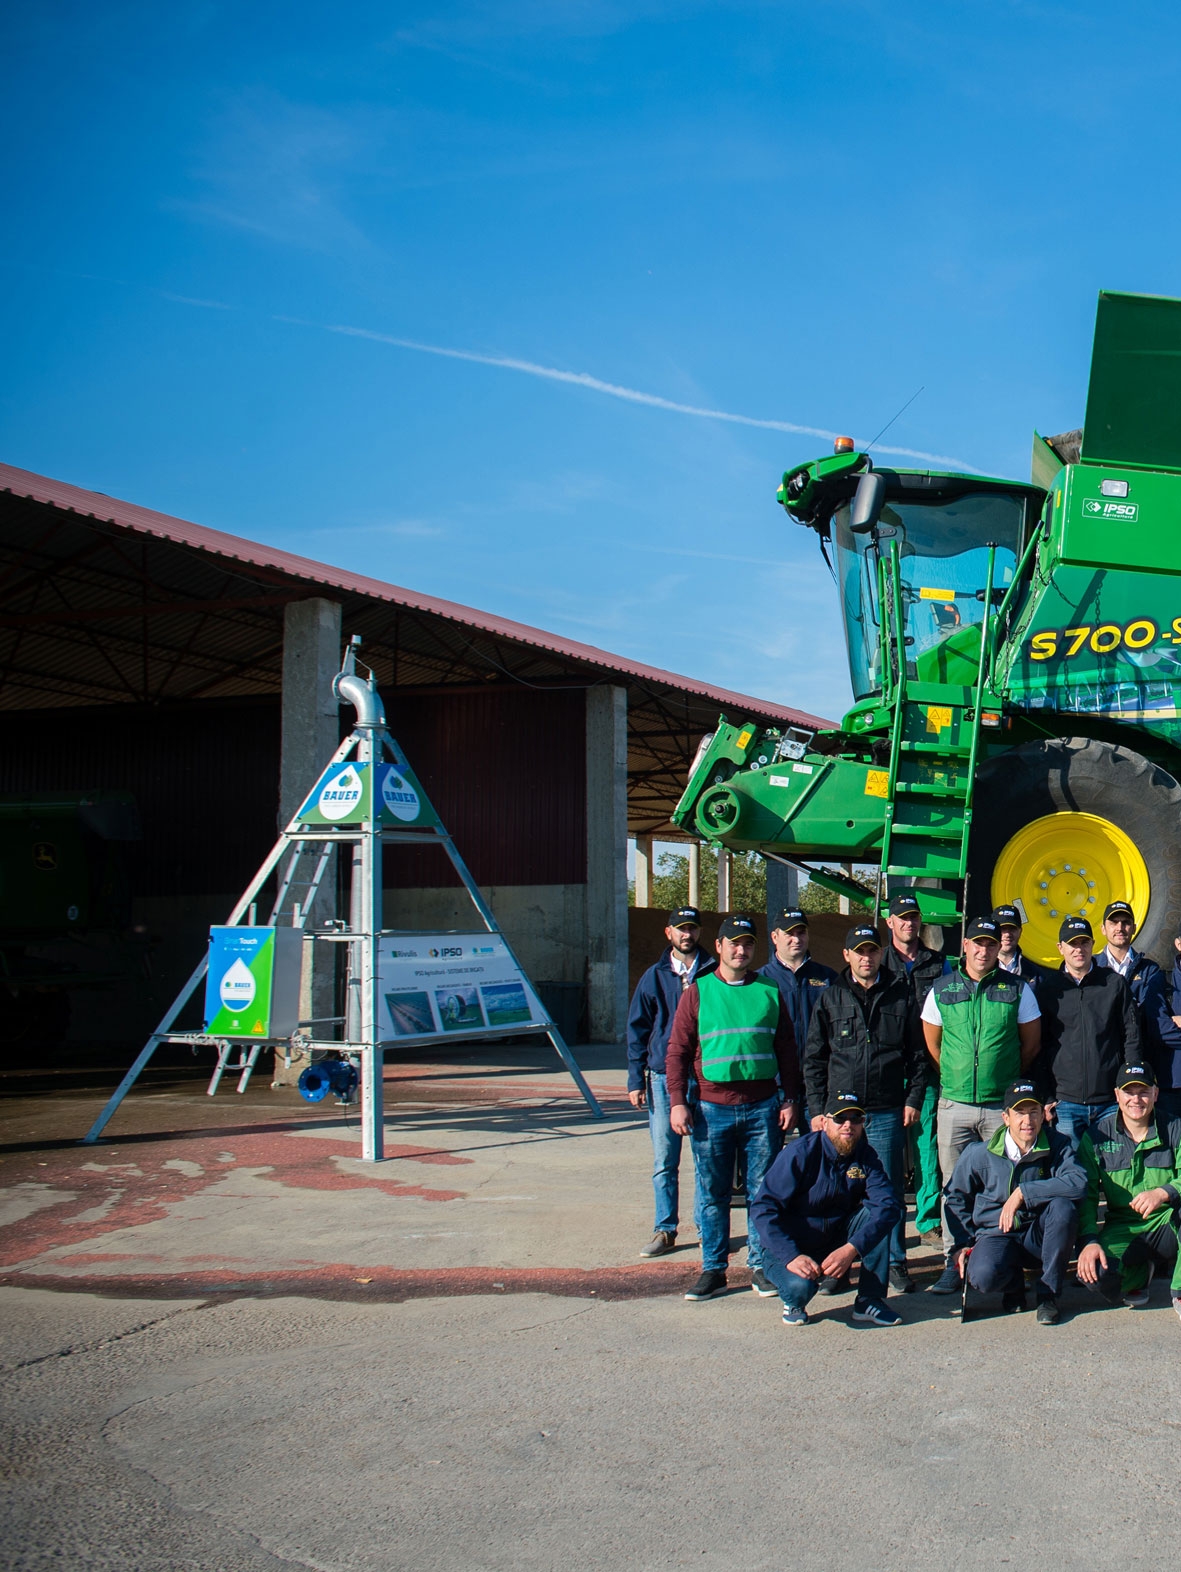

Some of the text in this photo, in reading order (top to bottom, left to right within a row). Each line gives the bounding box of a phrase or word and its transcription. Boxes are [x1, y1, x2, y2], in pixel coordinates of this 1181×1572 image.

[1103, 503, 1136, 515] IPSO
[322, 790, 359, 801] BAUER
[383, 790, 417, 803] BAUER
[441, 947, 463, 957] IPSO
